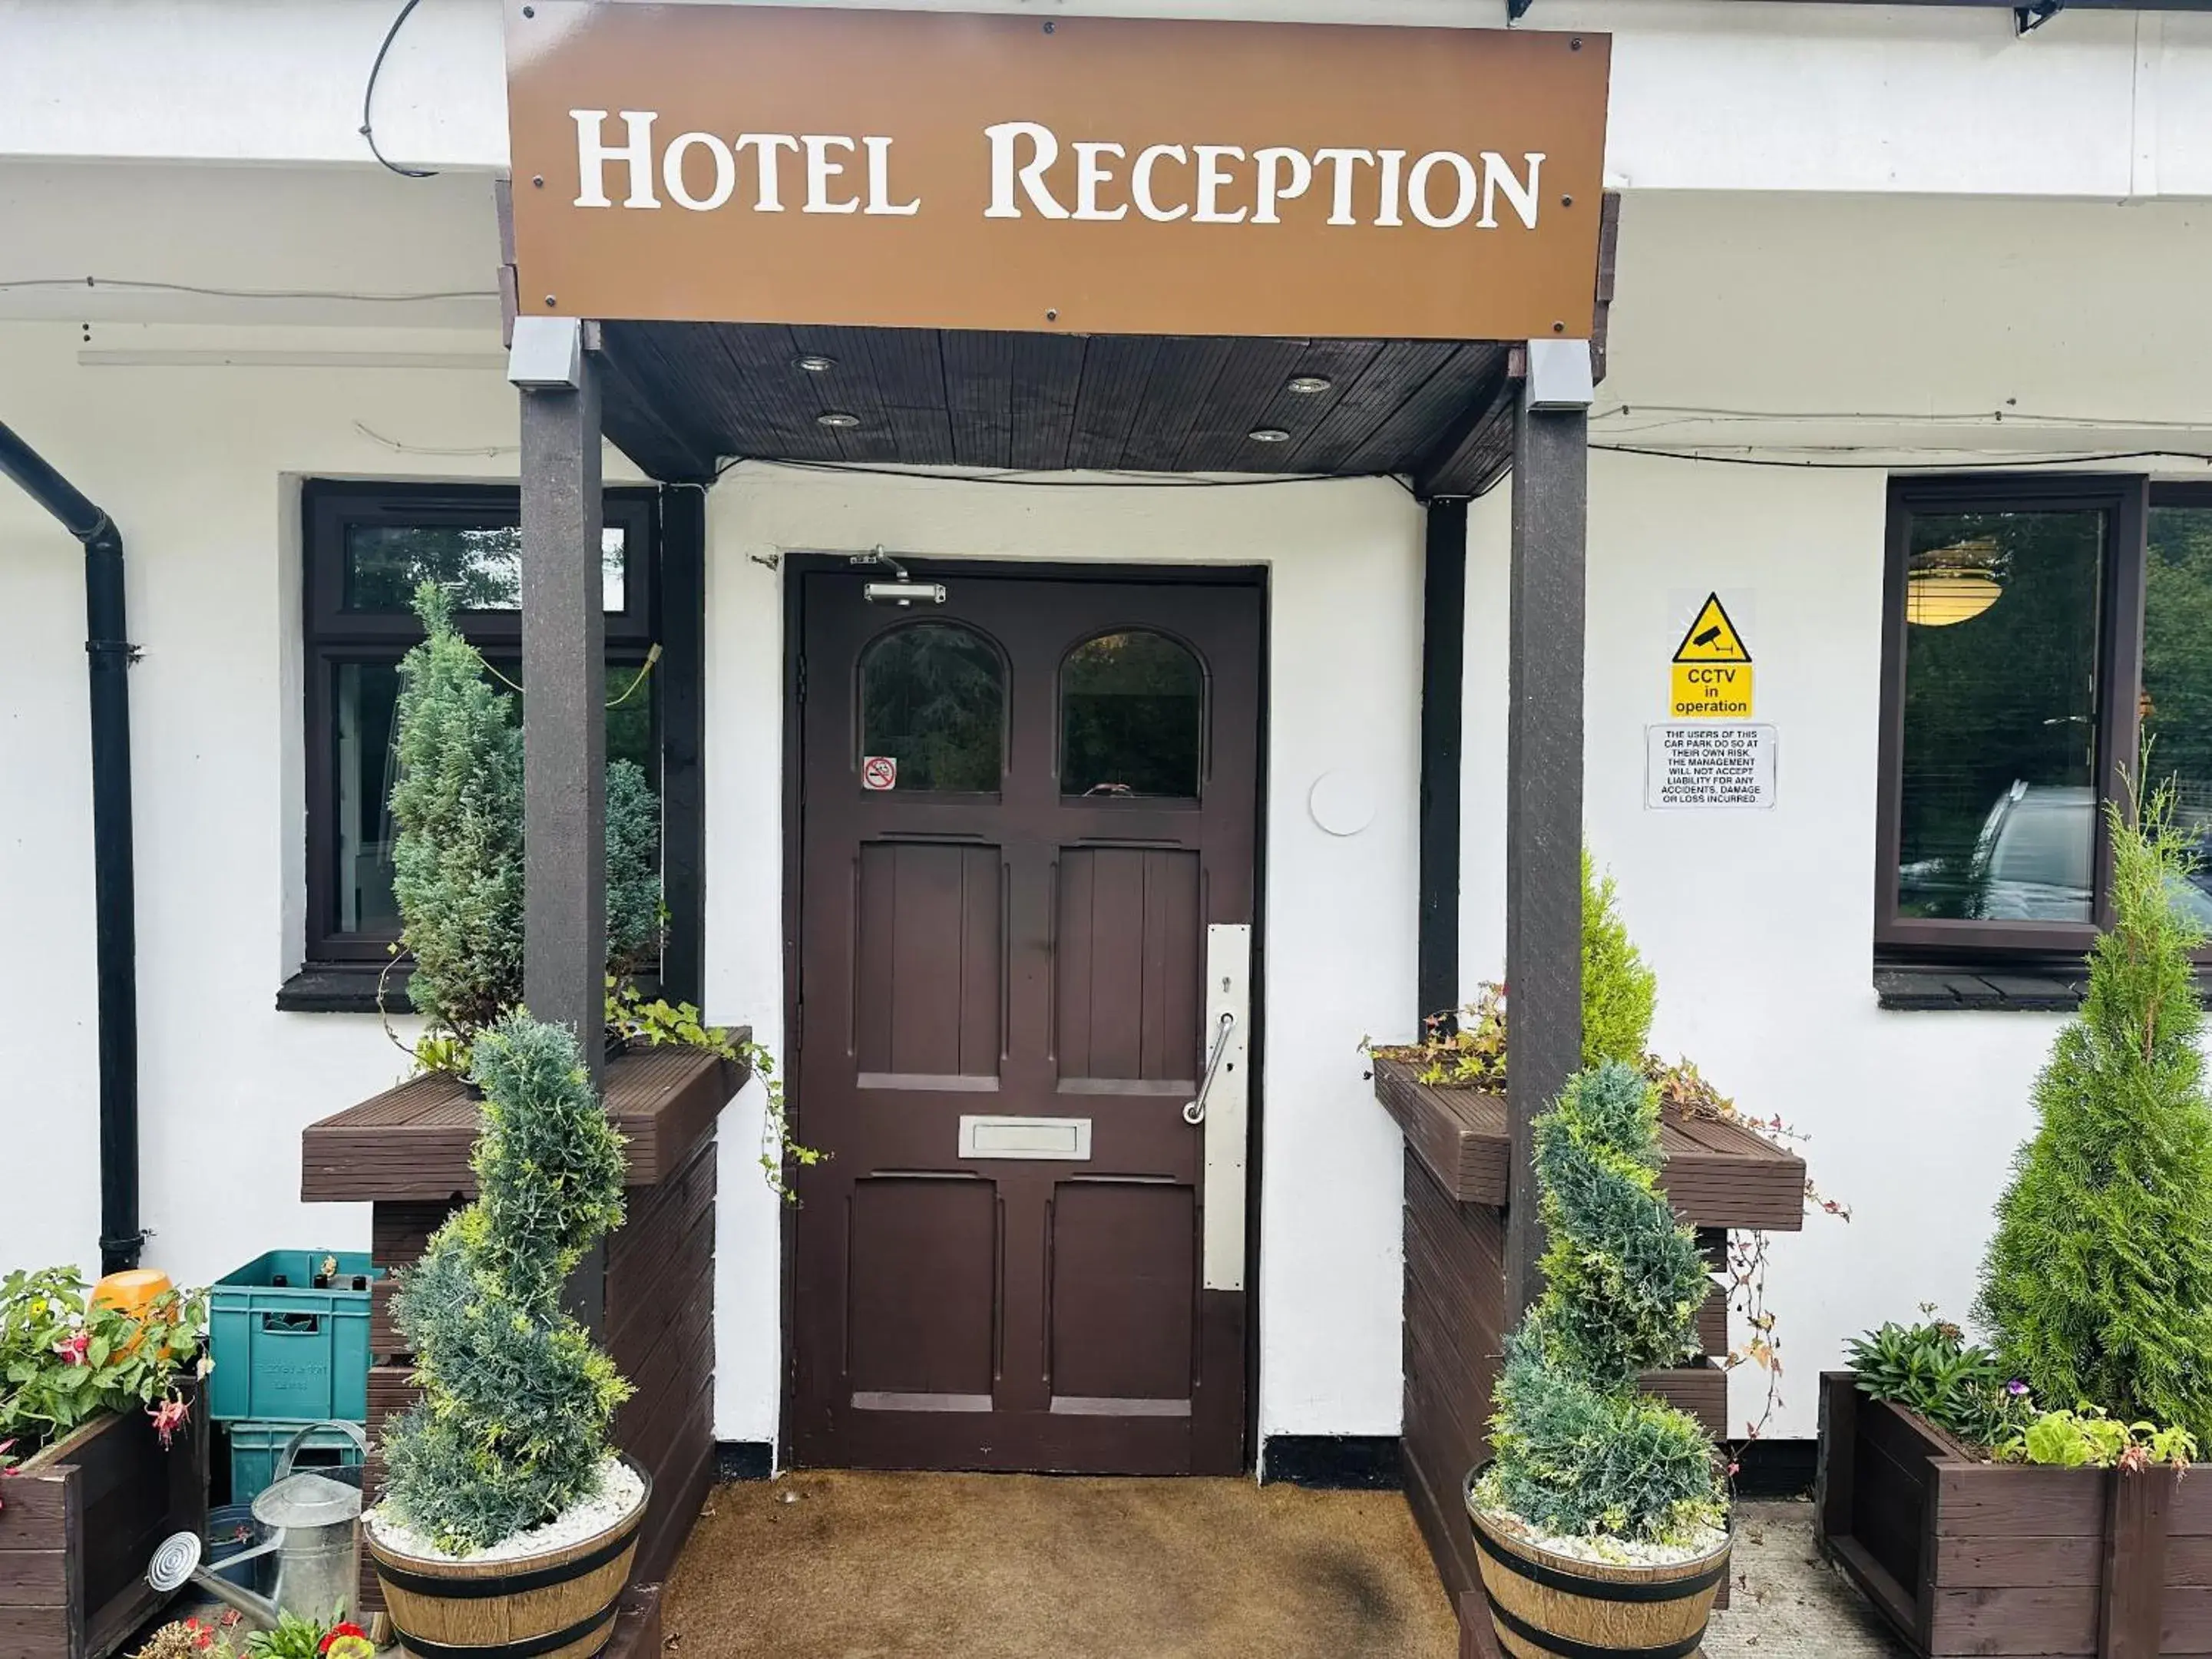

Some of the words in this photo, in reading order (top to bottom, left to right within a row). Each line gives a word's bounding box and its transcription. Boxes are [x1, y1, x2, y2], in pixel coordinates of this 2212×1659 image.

[569, 110, 921, 216] HOTEL
[984, 122, 1546, 230] RECEPTION
[1688, 669, 1736, 683] CCTV
[1704, 686, 1718, 697] in
[1676, 700, 1747, 714] operation
